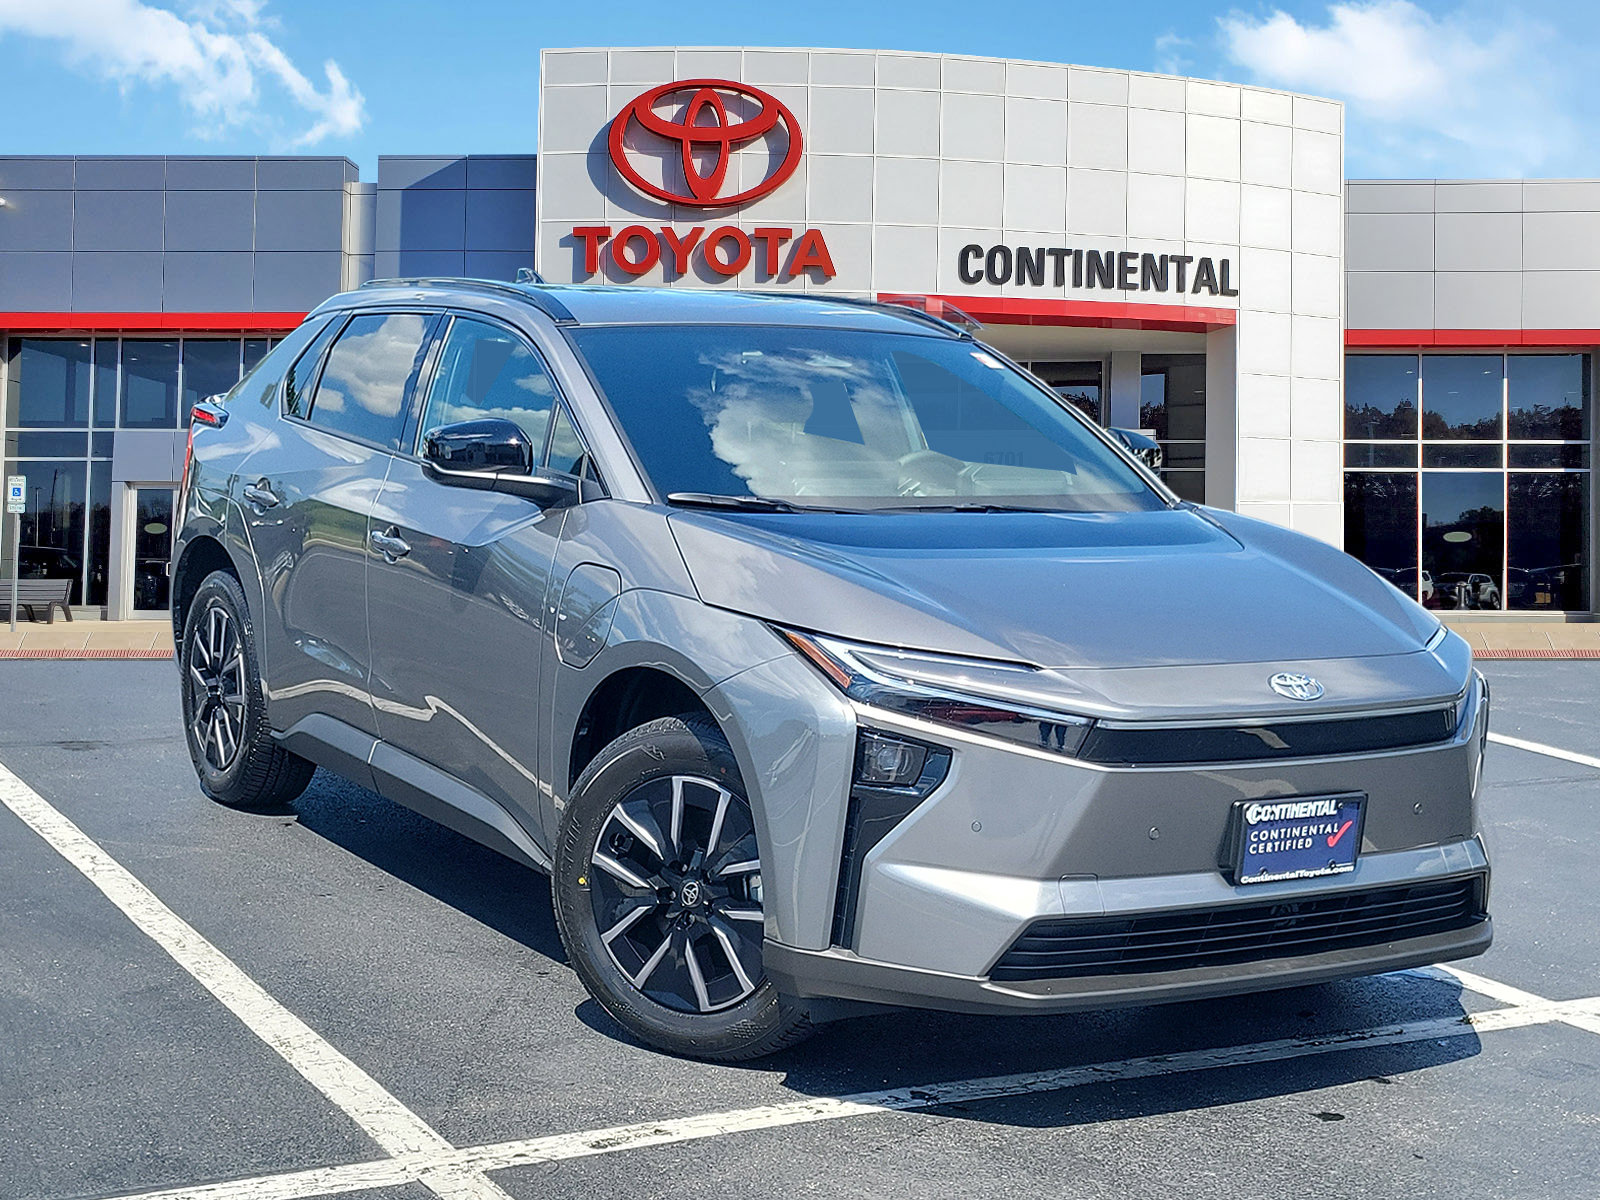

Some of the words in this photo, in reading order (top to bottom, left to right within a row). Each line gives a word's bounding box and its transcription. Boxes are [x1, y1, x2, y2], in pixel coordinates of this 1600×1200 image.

[573, 225, 836, 278] TOYOTA
[958, 243, 1239, 298] CONTINENTAL
[1245, 800, 1338, 825] CONTINENTAL
[1250, 823, 1339, 842] CONTINENTAL
[1249, 838, 1313, 855] CERTIFIED
[1240, 865, 1354, 884] ContinentalToyota.com
